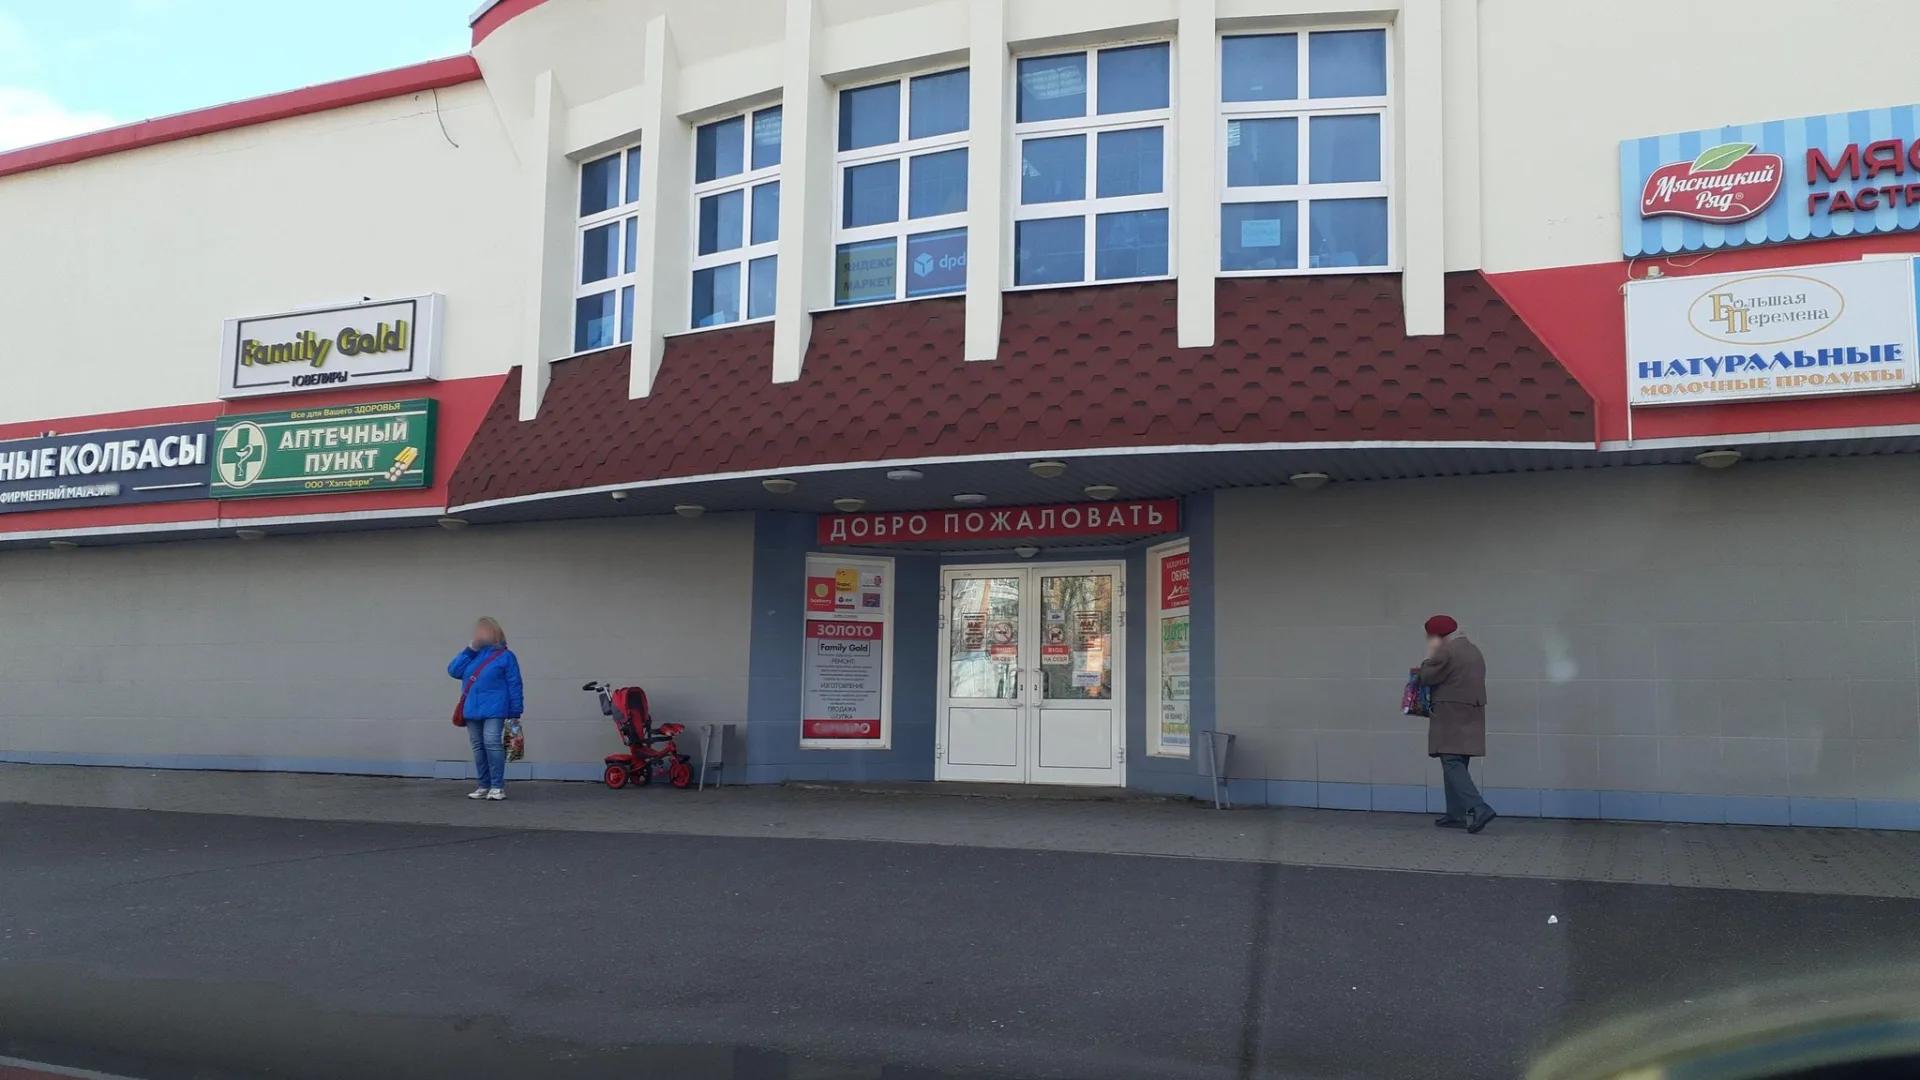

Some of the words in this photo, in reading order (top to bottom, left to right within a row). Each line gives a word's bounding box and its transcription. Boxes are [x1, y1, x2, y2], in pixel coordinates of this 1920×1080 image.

[1646, 164, 1774, 205] Мясницкий
[843, 257, 894, 273] ЯНДЕКС
[939, 252, 966, 271] dpd
[843, 276, 893, 291] МАРКЕТ
[1709, 291, 1807, 322] Большая
[1725, 308, 1830, 334] Перемена
[240, 330, 333, 368] Family
[336, 319, 408, 357] Gold
[1638, 343, 1905, 379] НАТУРАЛЬНЫЕ
[291, 371, 349, 387] ЮВЕЛИРЫ
[1640, 376, 1771, 397] МОЛОЧНЫЕ
[1775, 368, 1906, 389] ПРОДУКТЫ
[307, 410, 322, 419] для
[324, 407, 352, 417] Вашего
[354, 403, 401, 414] ЗДОРОВЬЯ
[277, 417, 410, 451] АПТЕЧНЫЙ
[59, 433, 207, 476] КОЛБАСЫ
[304, 449, 380, 474] ПУНКТ
[0, 485, 67, 504] ФИРМЕННЫЙ
[66, 481, 120, 499] МАГАЗИ
[304, 480, 324, 489] ООО
[830, 515, 927, 541] ДОБРО
[944, 504, 1164, 533] ПОЖАЛОВАТЬ
[817, 624, 874, 637] ЗОЛОТО
[820, 643, 847, 653] Family
[848, 643, 868, 652] Gold
